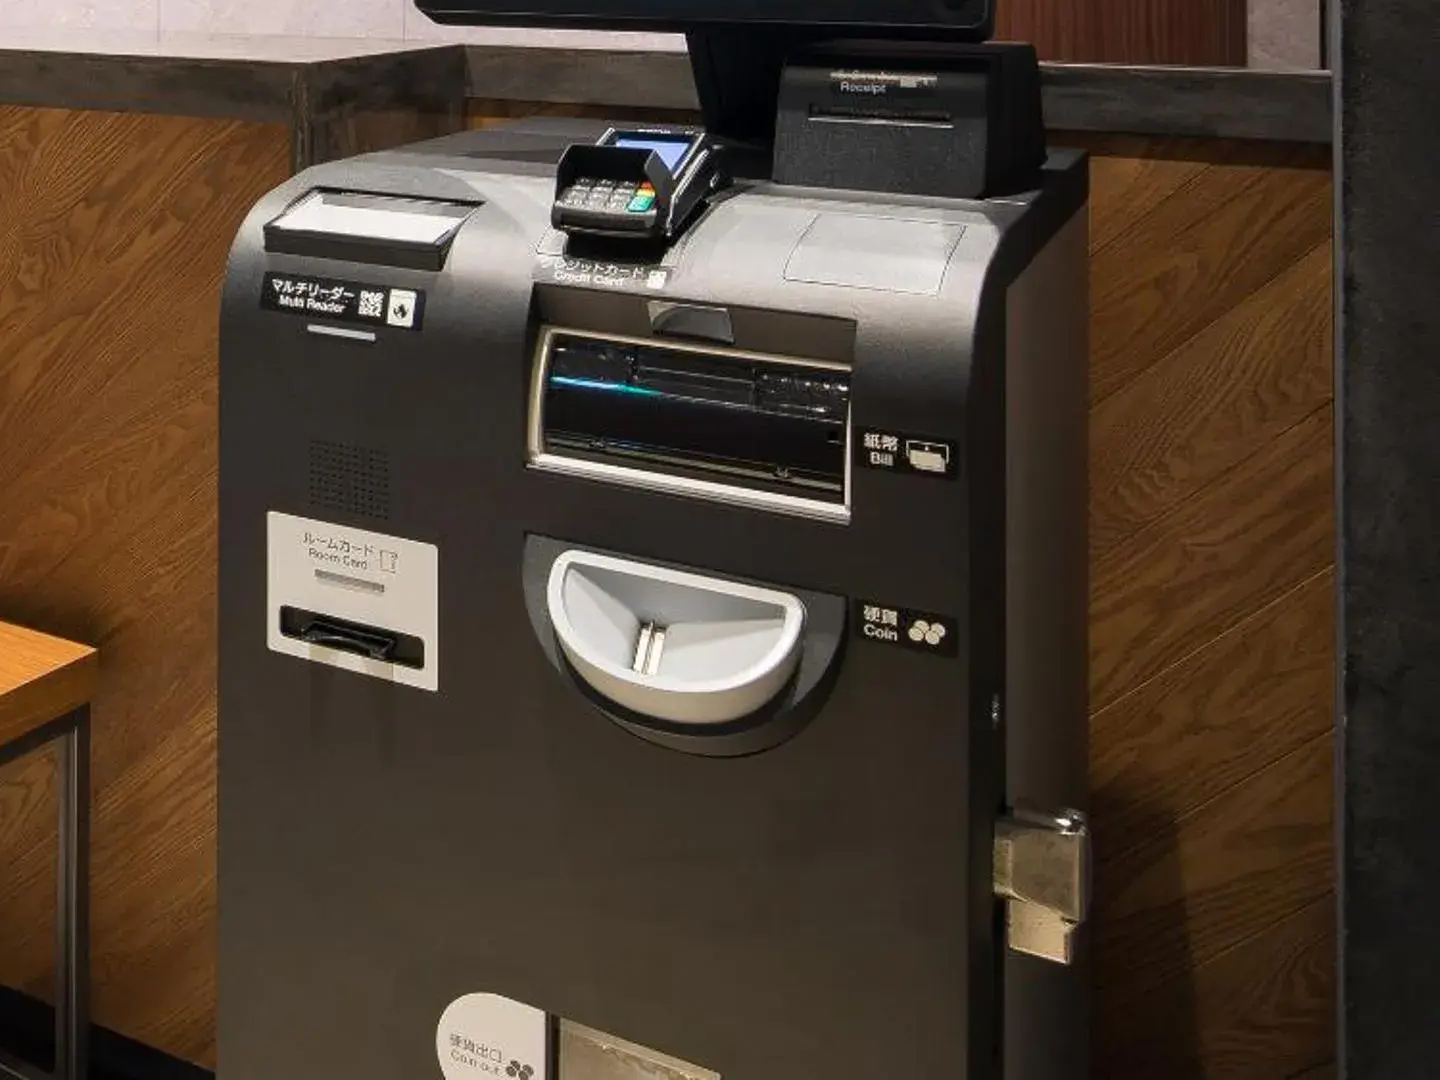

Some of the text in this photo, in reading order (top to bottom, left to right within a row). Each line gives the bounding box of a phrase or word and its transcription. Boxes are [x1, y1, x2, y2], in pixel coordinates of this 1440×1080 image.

[271, 278, 356, 300] マルチリーダー
[278, 294, 347, 314] Multi Reader
[303, 532, 374, 556] ルームカード
[308, 548, 368, 570] Room Card
[863, 623, 898, 641] Coin
